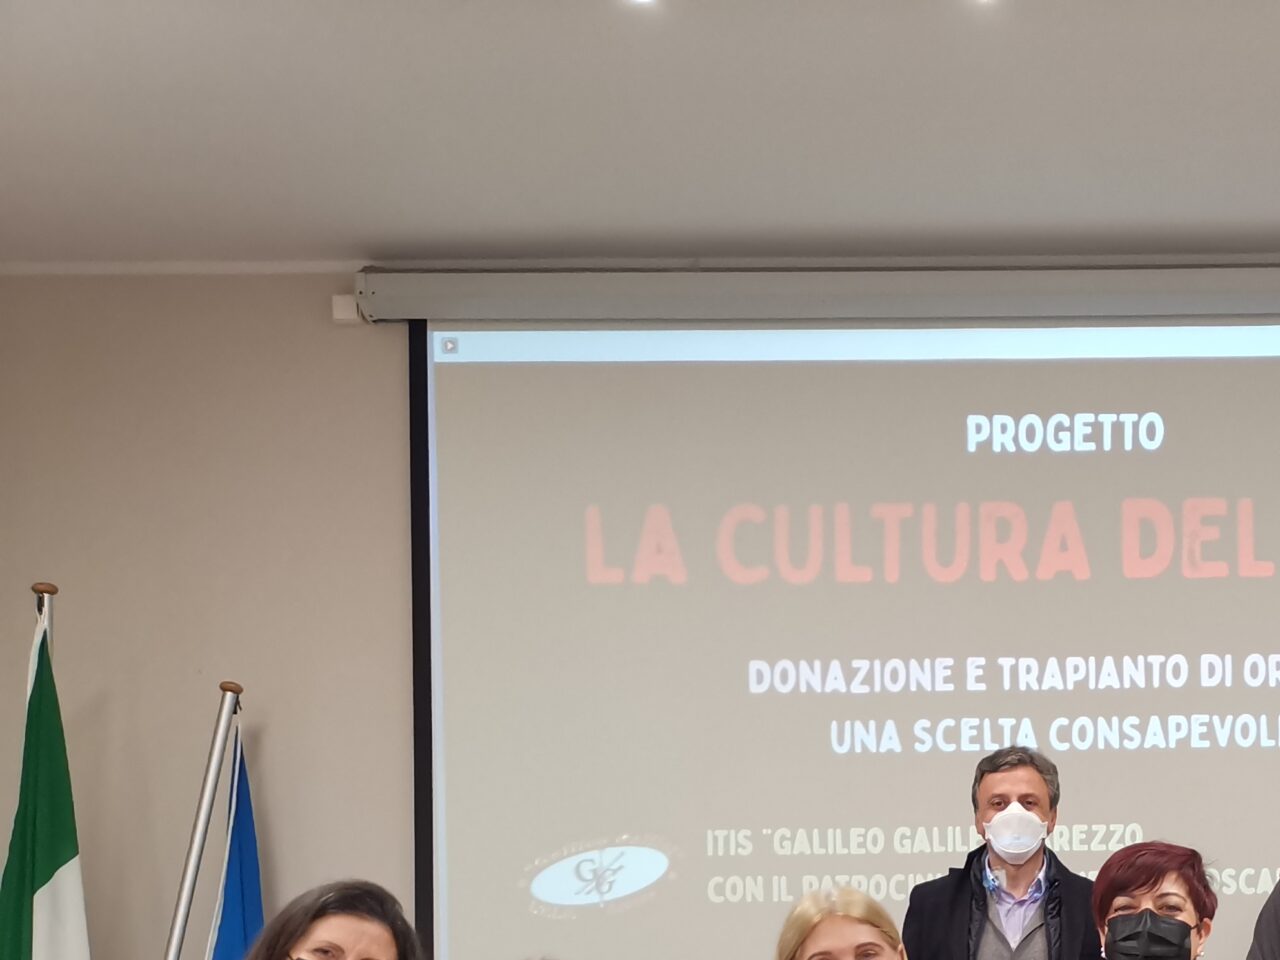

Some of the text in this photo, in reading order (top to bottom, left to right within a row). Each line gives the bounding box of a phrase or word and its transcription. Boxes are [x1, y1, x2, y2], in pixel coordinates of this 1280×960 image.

[967, 412, 1164, 453] PROGETTO
[584, 502, 689, 585] LA
[716, 499, 1091, 585] CULTURA
[1121, 497, 1276, 579] DEL
[748, 657, 955, 694] DONAZIONE
[966, 656, 987, 691] E
[997, 652, 1189, 691] TRAPIANTO
[1200, 652, 1233, 688] DI
[830, 718, 903, 754] UNA
[913, 716, 1038, 753] SCELTA
[706, 829, 753, 857] ITIS
[707, 875, 764, 903] CON
[772, 875, 794, 902] IL
